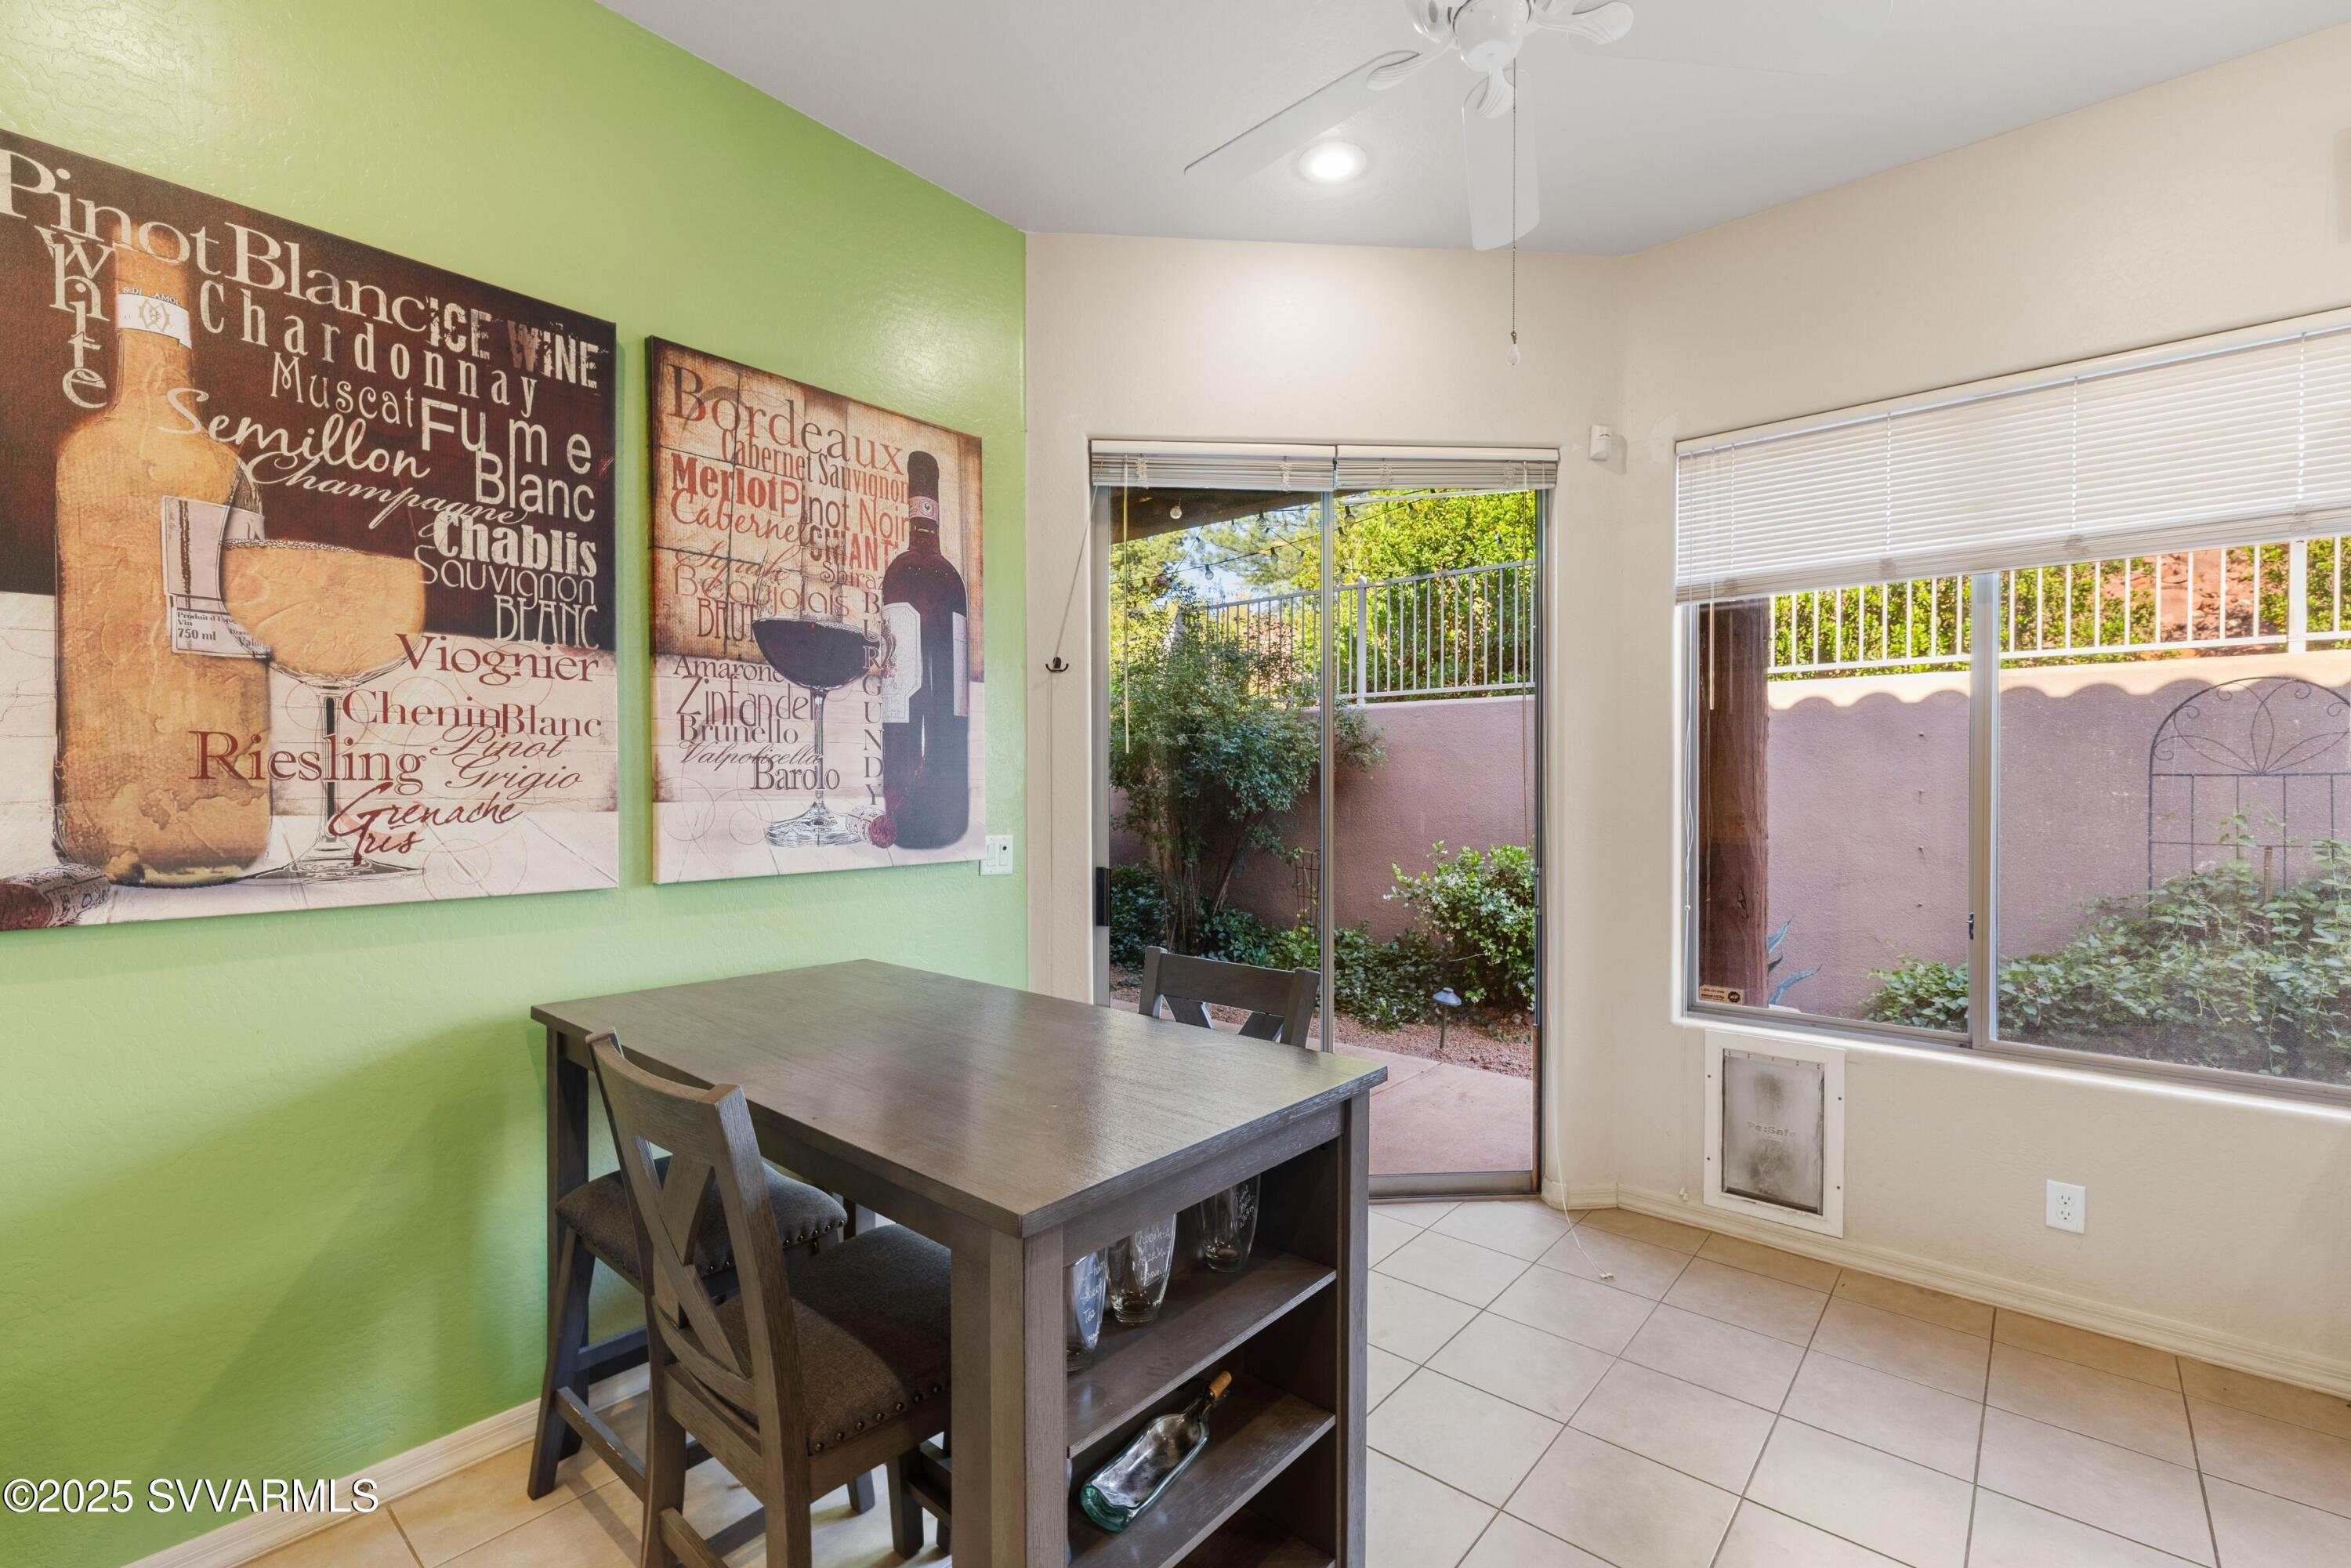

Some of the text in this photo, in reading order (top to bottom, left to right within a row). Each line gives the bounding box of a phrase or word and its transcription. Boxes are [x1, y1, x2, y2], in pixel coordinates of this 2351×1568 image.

[0, 148, 426, 331] Pinot Blanc
[200, 280, 538, 418] Chardonnay
[270, 352, 415, 428] Muscat
[668, 364, 904, 475] Bordeaux
[157, 388, 430, 479] Semillon
[421, 397, 592, 475] Fume
[476, 440, 595, 523] Blanc
[671, 452, 777, 512] Merlot
[722, 429, 909, 505] Cabernet Sauvignon
[670, 487, 812, 546] Cabernet
[781, 480, 909, 542] Pinot Noir
[433, 509, 597, 578] Chablis
[414, 545, 595, 610] Sauvignon
[178, 628, 199, 639] 750
[201, 631, 216, 640] ml
[494, 594, 600, 650] BLANC
[697, 597, 758, 642] BRUT
[395, 633, 599, 686] Viognier
[672, 655, 784, 683] Amarone
[342, 690, 601, 738] Chenin Blanc
[676, 675, 814, 727] Zinfandel
[678, 714, 799, 744] Brunello
[188, 730, 426, 795] Riesling
[430, 725, 571, 759] Pinot
[445, 752, 583, 800] Grigio
[750, 756, 840, 790] Barolo
